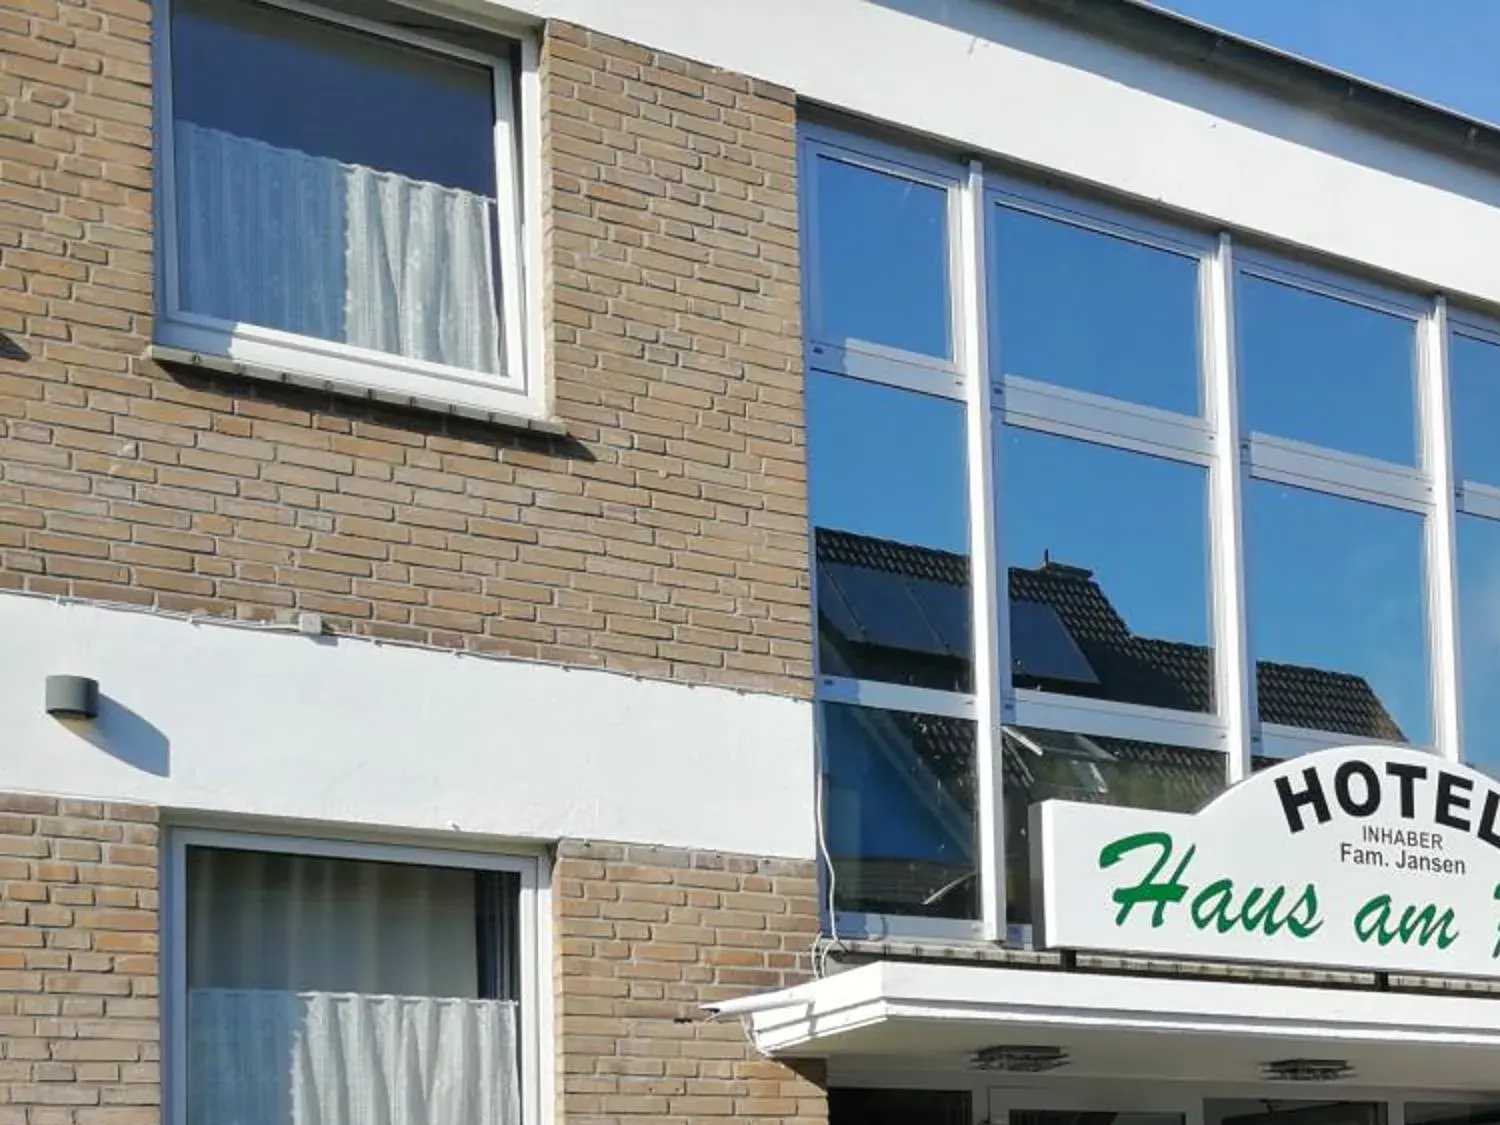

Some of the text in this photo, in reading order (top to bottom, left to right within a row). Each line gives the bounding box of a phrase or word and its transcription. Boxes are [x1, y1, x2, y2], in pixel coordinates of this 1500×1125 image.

[1362, 825, 1443, 849] INHABER
[1340, 842, 1466, 875] Fam. Jansen
[1099, 831, 1325, 938] Haus
[1353, 893, 1459, 949] am
